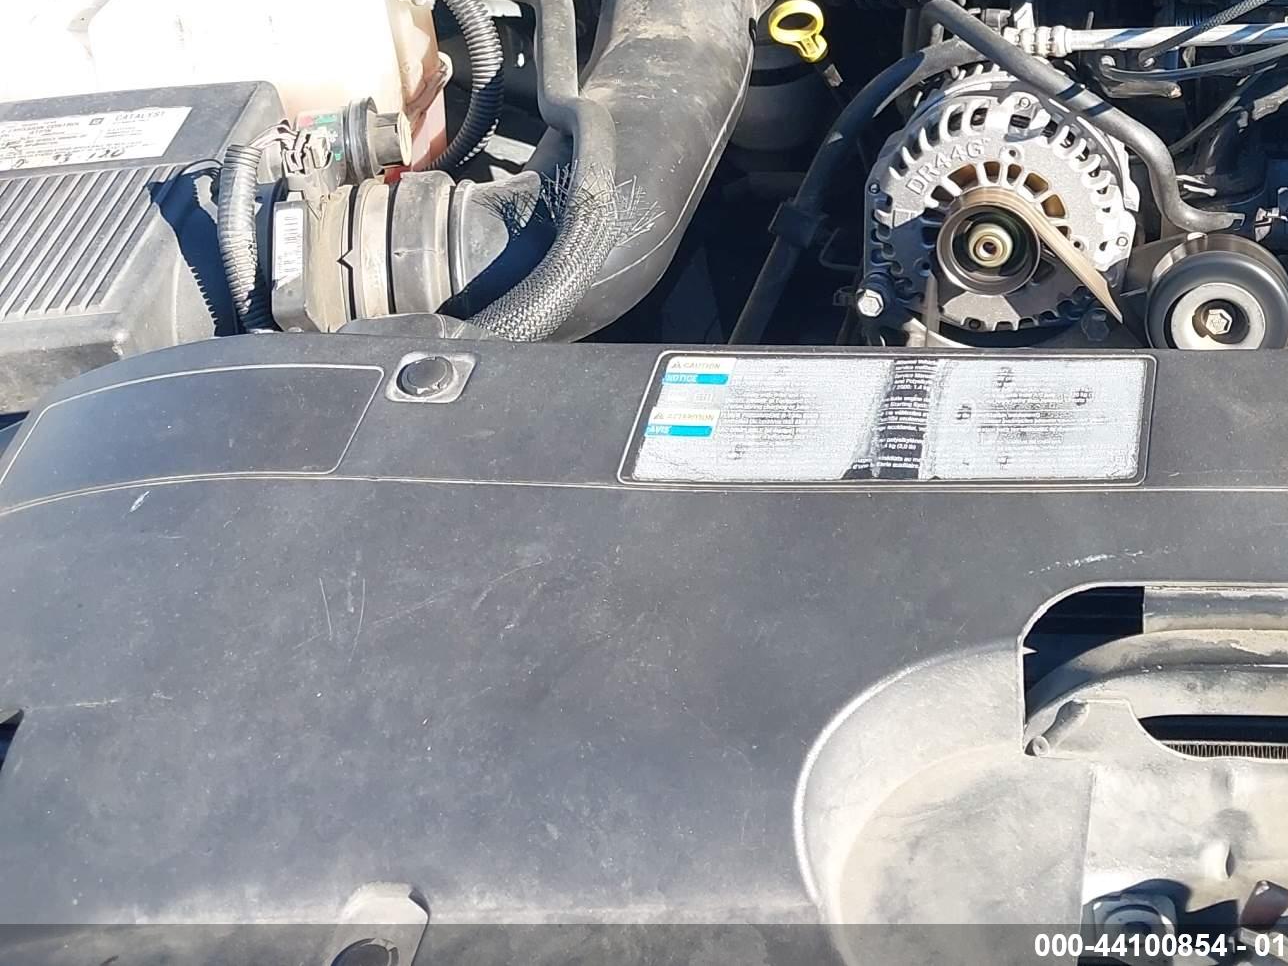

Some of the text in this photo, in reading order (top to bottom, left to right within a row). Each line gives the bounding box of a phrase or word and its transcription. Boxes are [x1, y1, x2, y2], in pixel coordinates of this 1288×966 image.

[683, 362, 721, 370] CAUTION
[664, 374, 698, 382] NOTICE
[647, 425, 671, 434] AVIS
